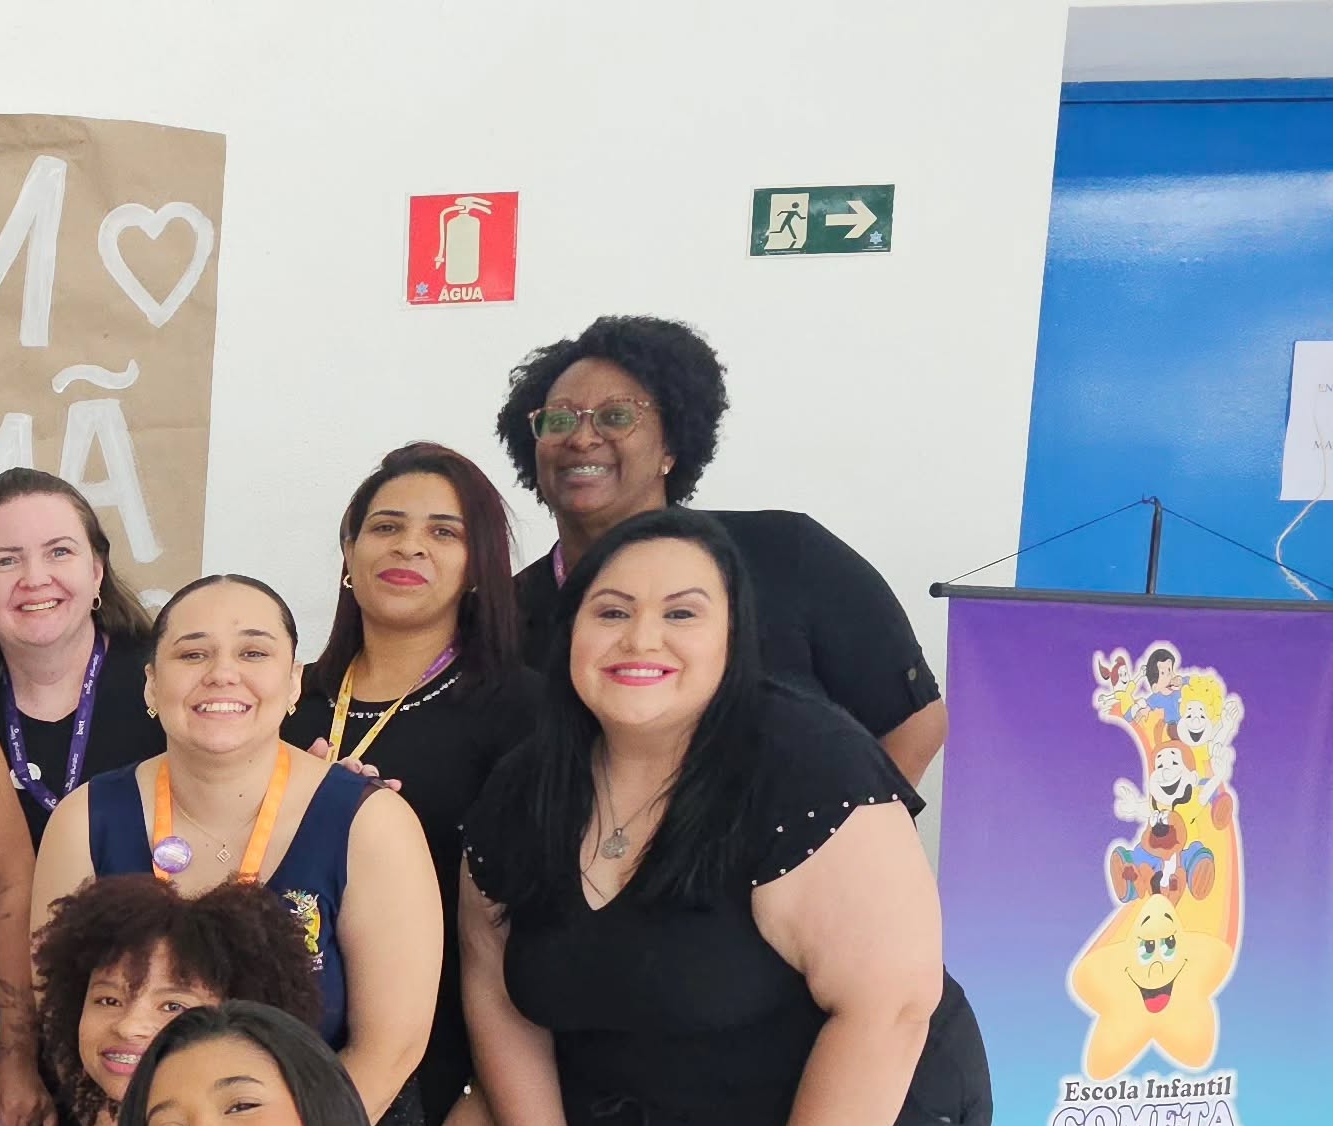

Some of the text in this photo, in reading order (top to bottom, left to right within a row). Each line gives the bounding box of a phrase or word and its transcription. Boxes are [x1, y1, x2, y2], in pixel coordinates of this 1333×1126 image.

[438, 284, 483, 301] ÁGUA
[1065, 1076, 1232, 1102] Escola Infantil
